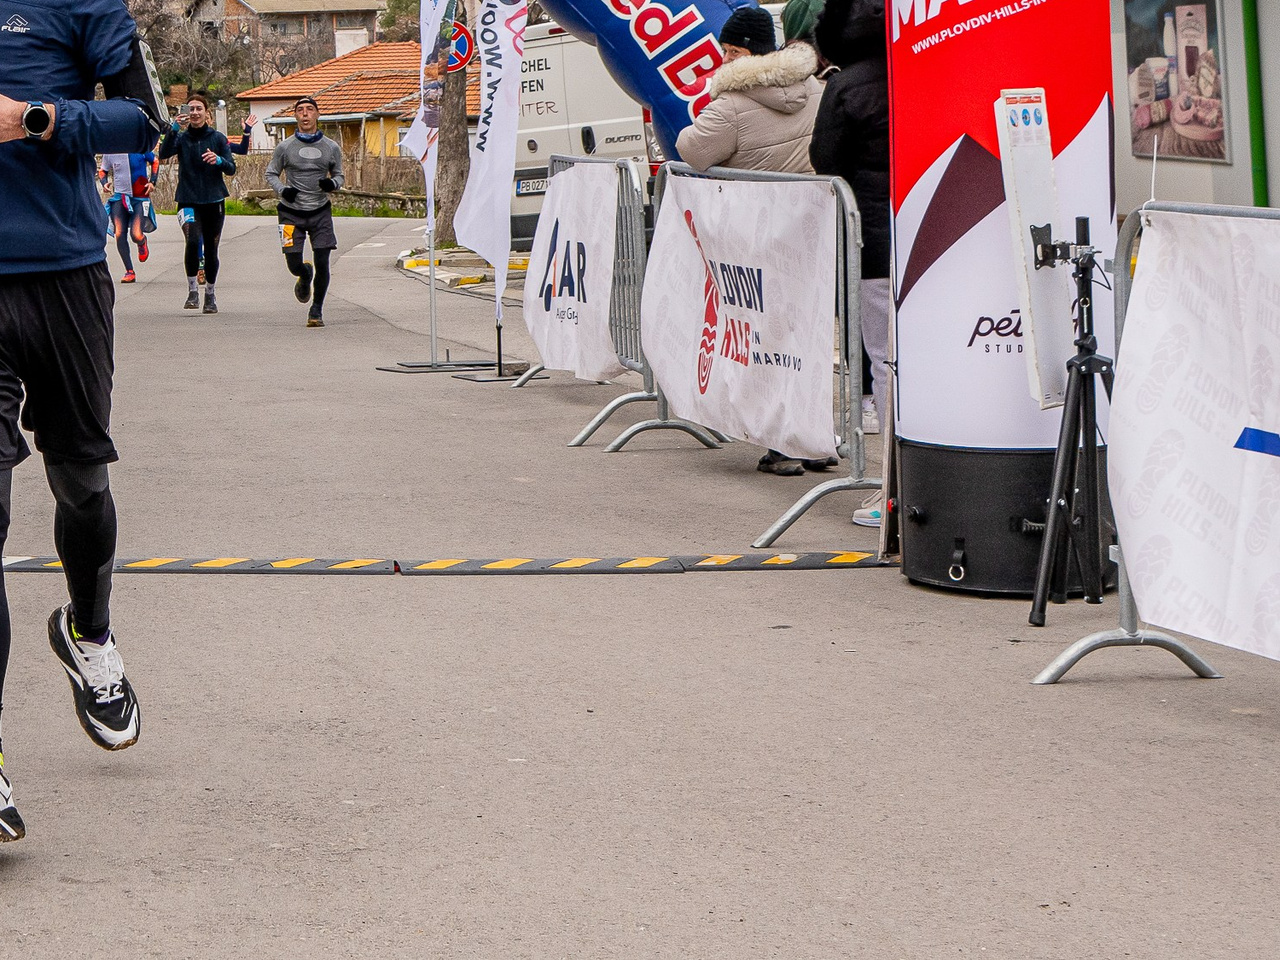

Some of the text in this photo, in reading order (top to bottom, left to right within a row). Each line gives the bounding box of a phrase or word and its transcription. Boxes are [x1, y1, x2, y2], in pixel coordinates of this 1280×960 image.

[605, 134, 642, 144] DUCATO
[984, 344, 1024, 353] STUD
[752, 351, 802, 372] MARKOVO
